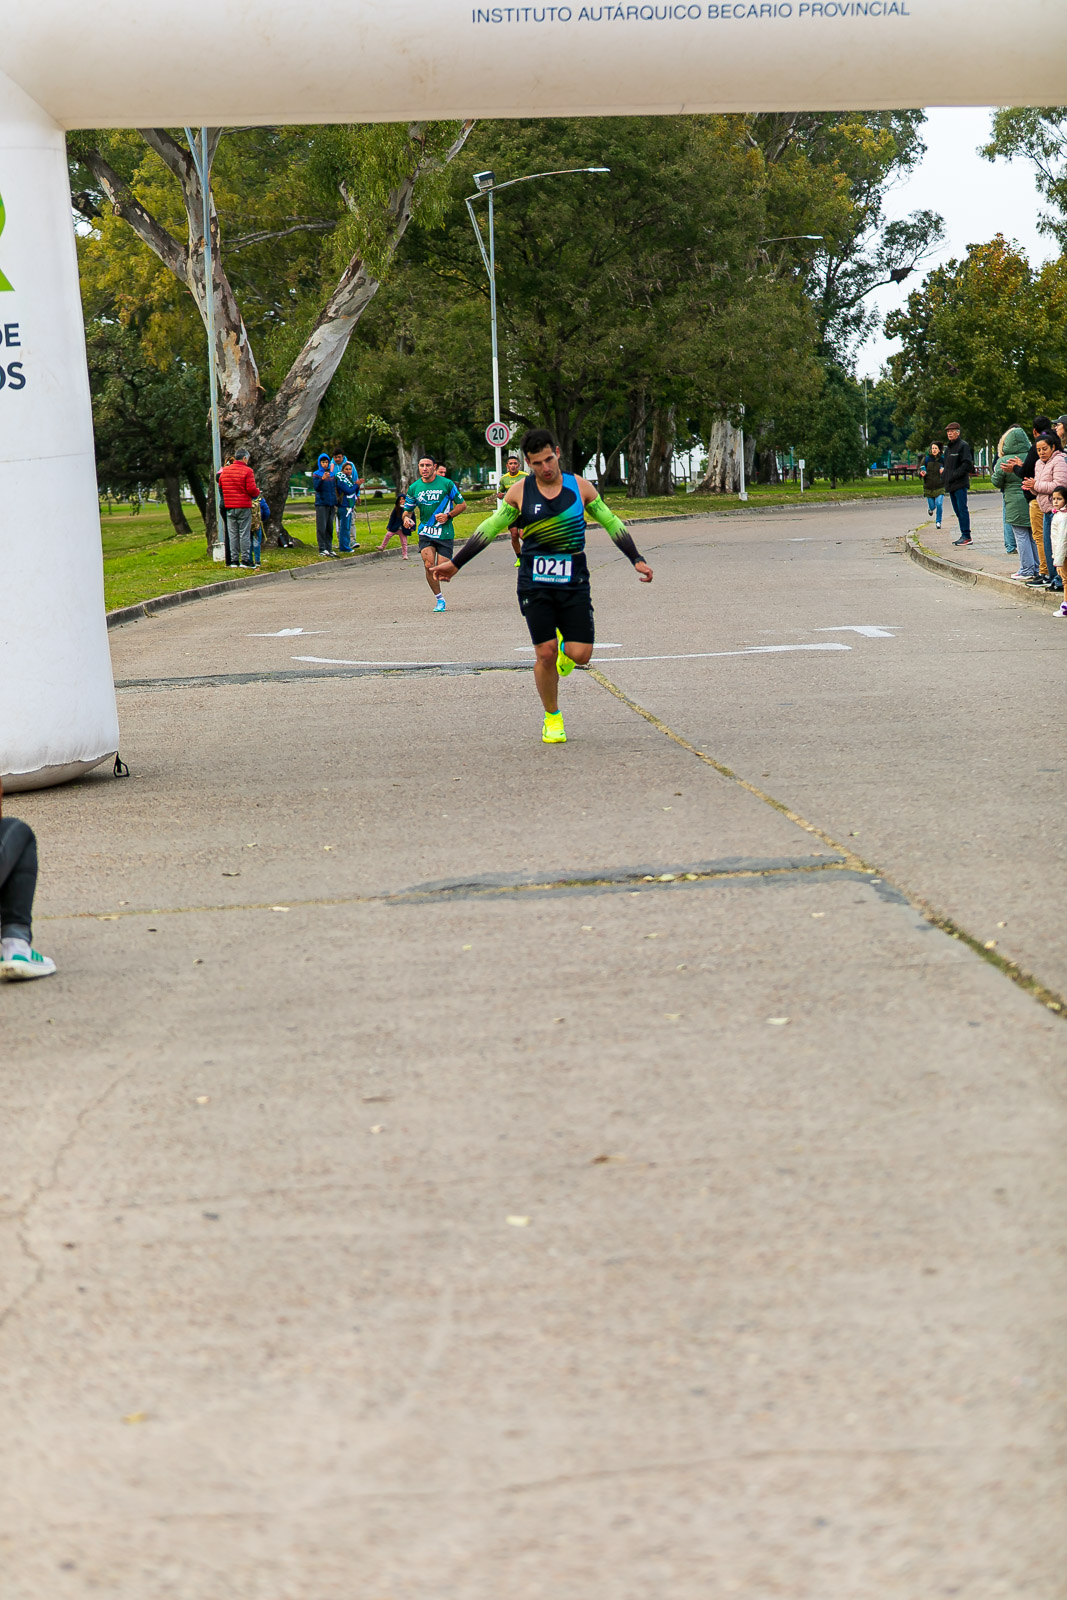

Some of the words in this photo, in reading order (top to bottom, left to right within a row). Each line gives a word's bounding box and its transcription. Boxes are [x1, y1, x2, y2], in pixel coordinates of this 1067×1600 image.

[472, 6, 572, 24] INSTITUTO
[578, 2, 702, 22] AUTÁRQUICO
[707, 3, 793, 20] BECARIO
[799, 1, 910, 18] PROVINCIAL
[0, 322, 21, 347] E
[492, 428, 505, 440] 20
[534, 503, 542, 515] F
[536, 557, 566, 576] 021
